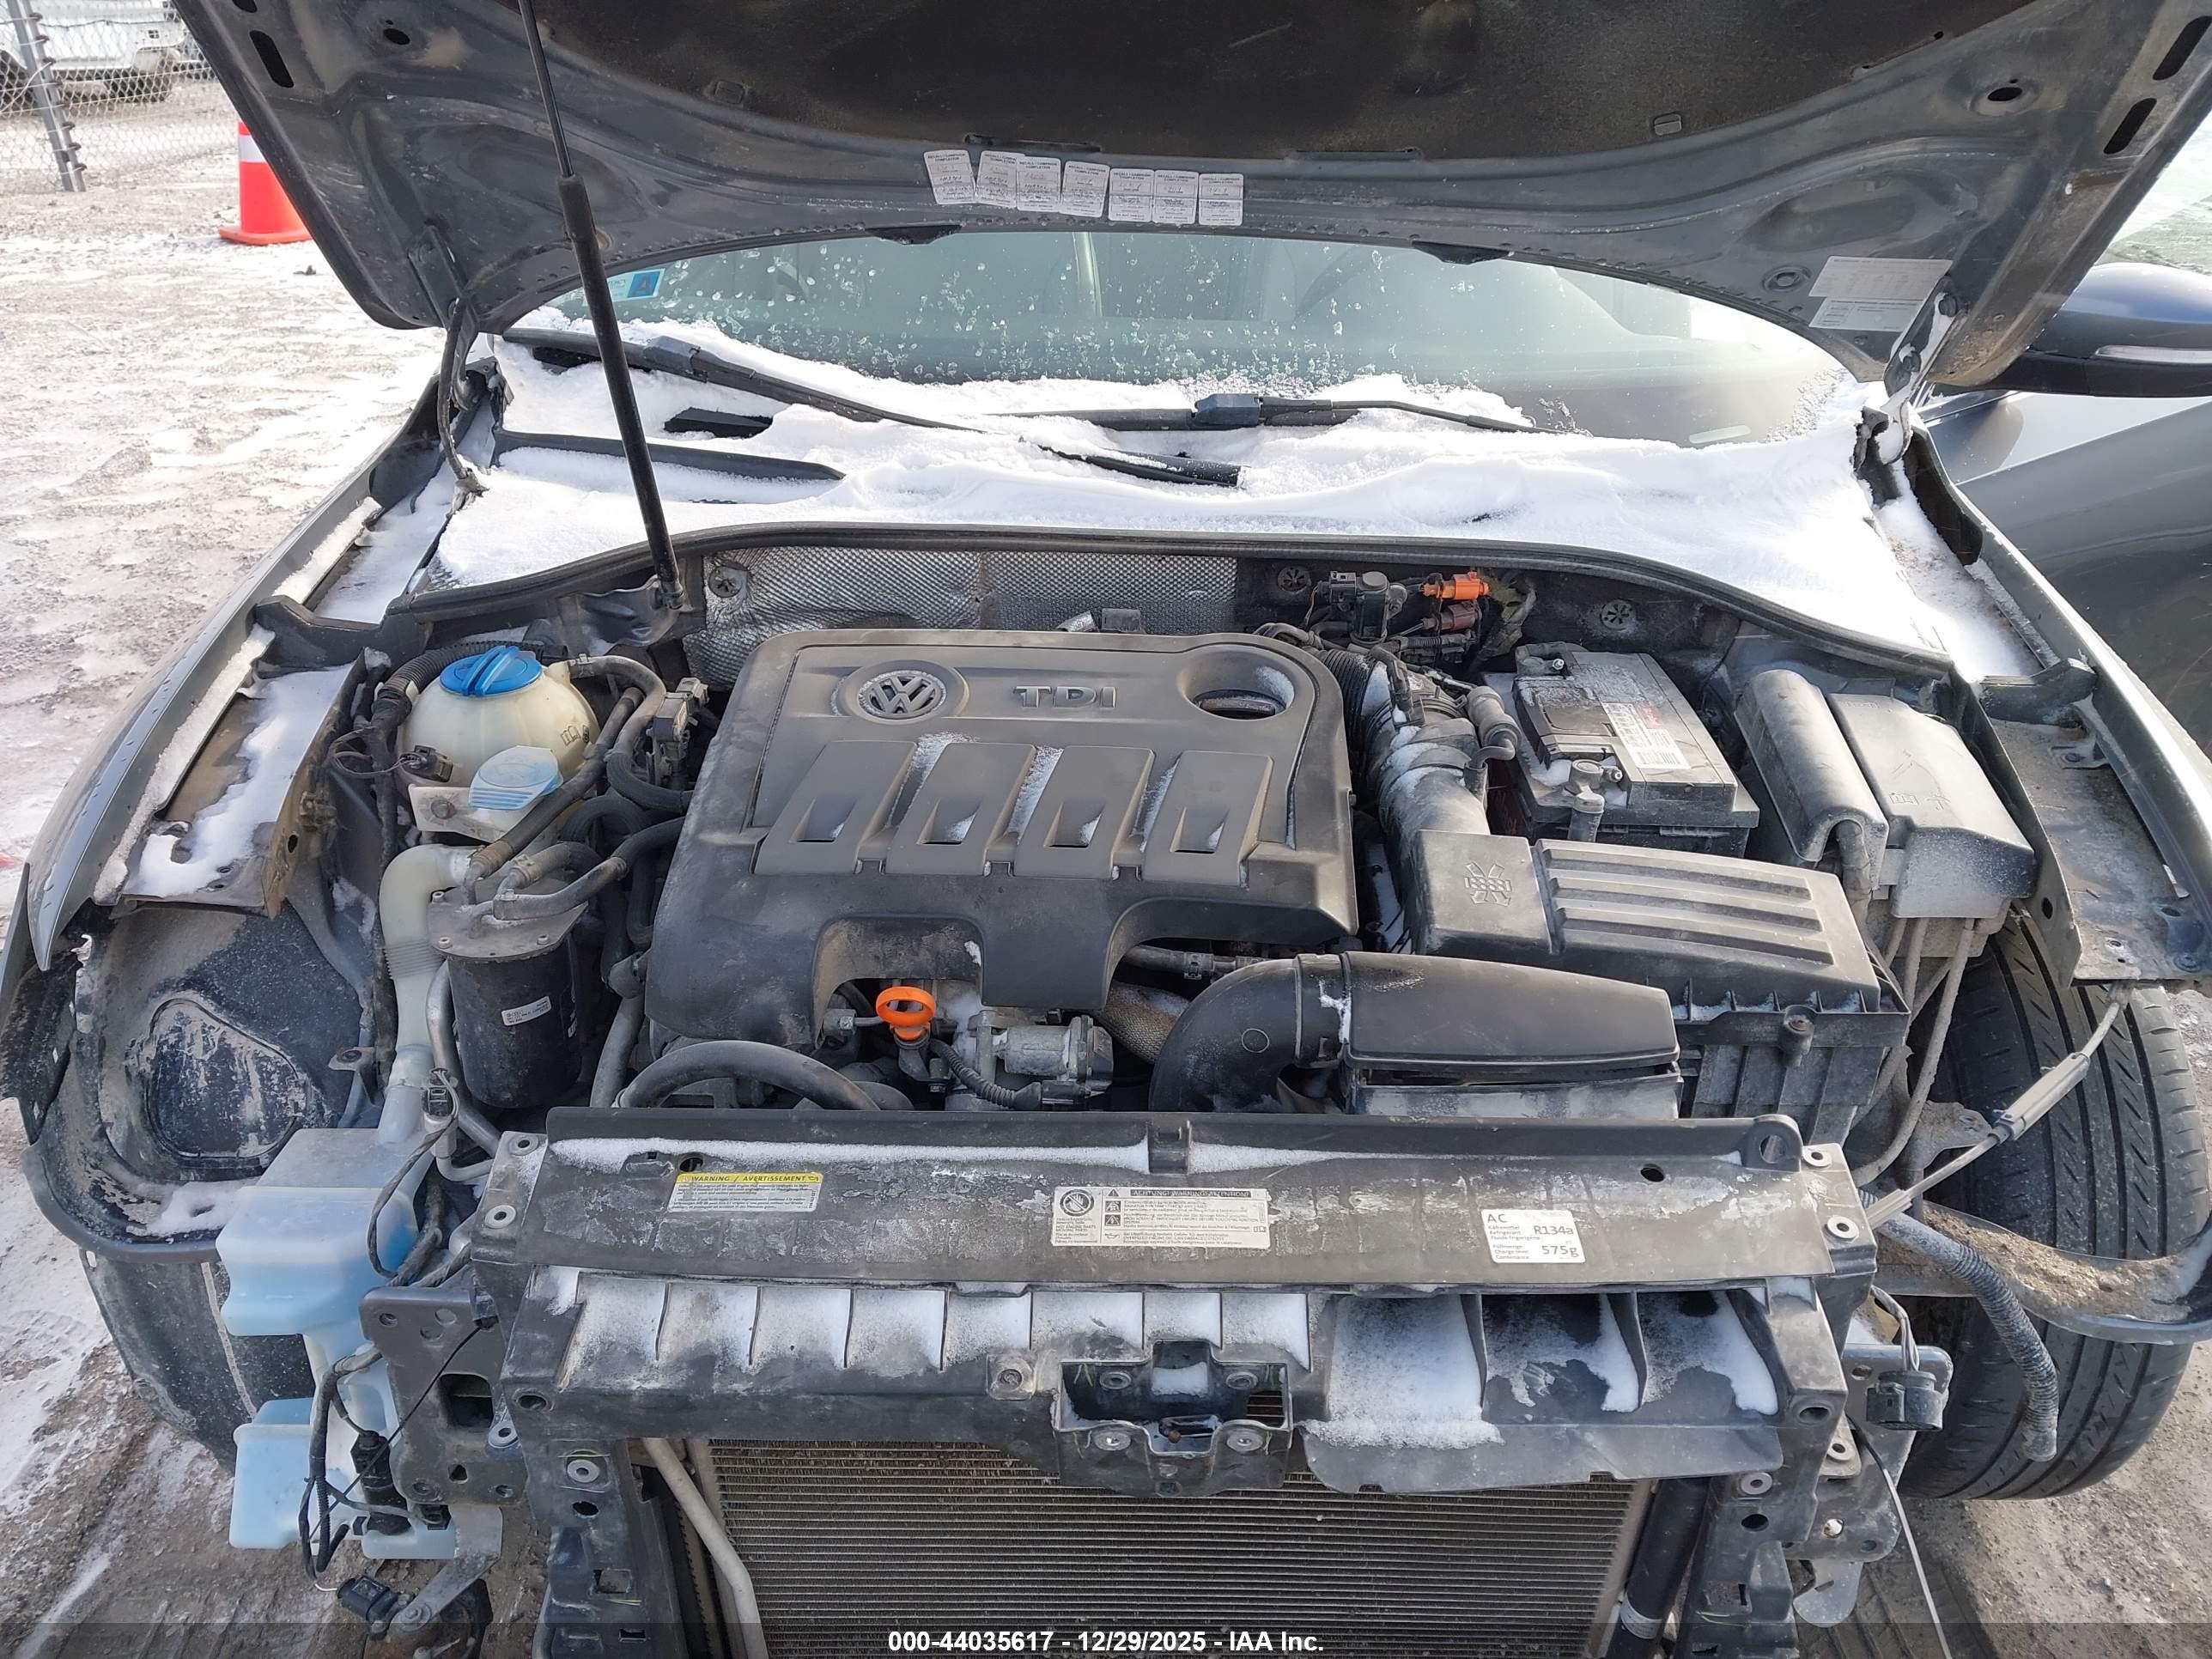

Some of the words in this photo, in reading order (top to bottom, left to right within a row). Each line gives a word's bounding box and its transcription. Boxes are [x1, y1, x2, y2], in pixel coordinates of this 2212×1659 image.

[866, 672, 942, 718] VW
[1012, 685, 1117, 709] TDI
[742, 1174, 806, 1182] AVERTISSEMENT
[1487, 1213, 1508, 1224] AC
[1533, 1224, 1574, 1235] R134a
